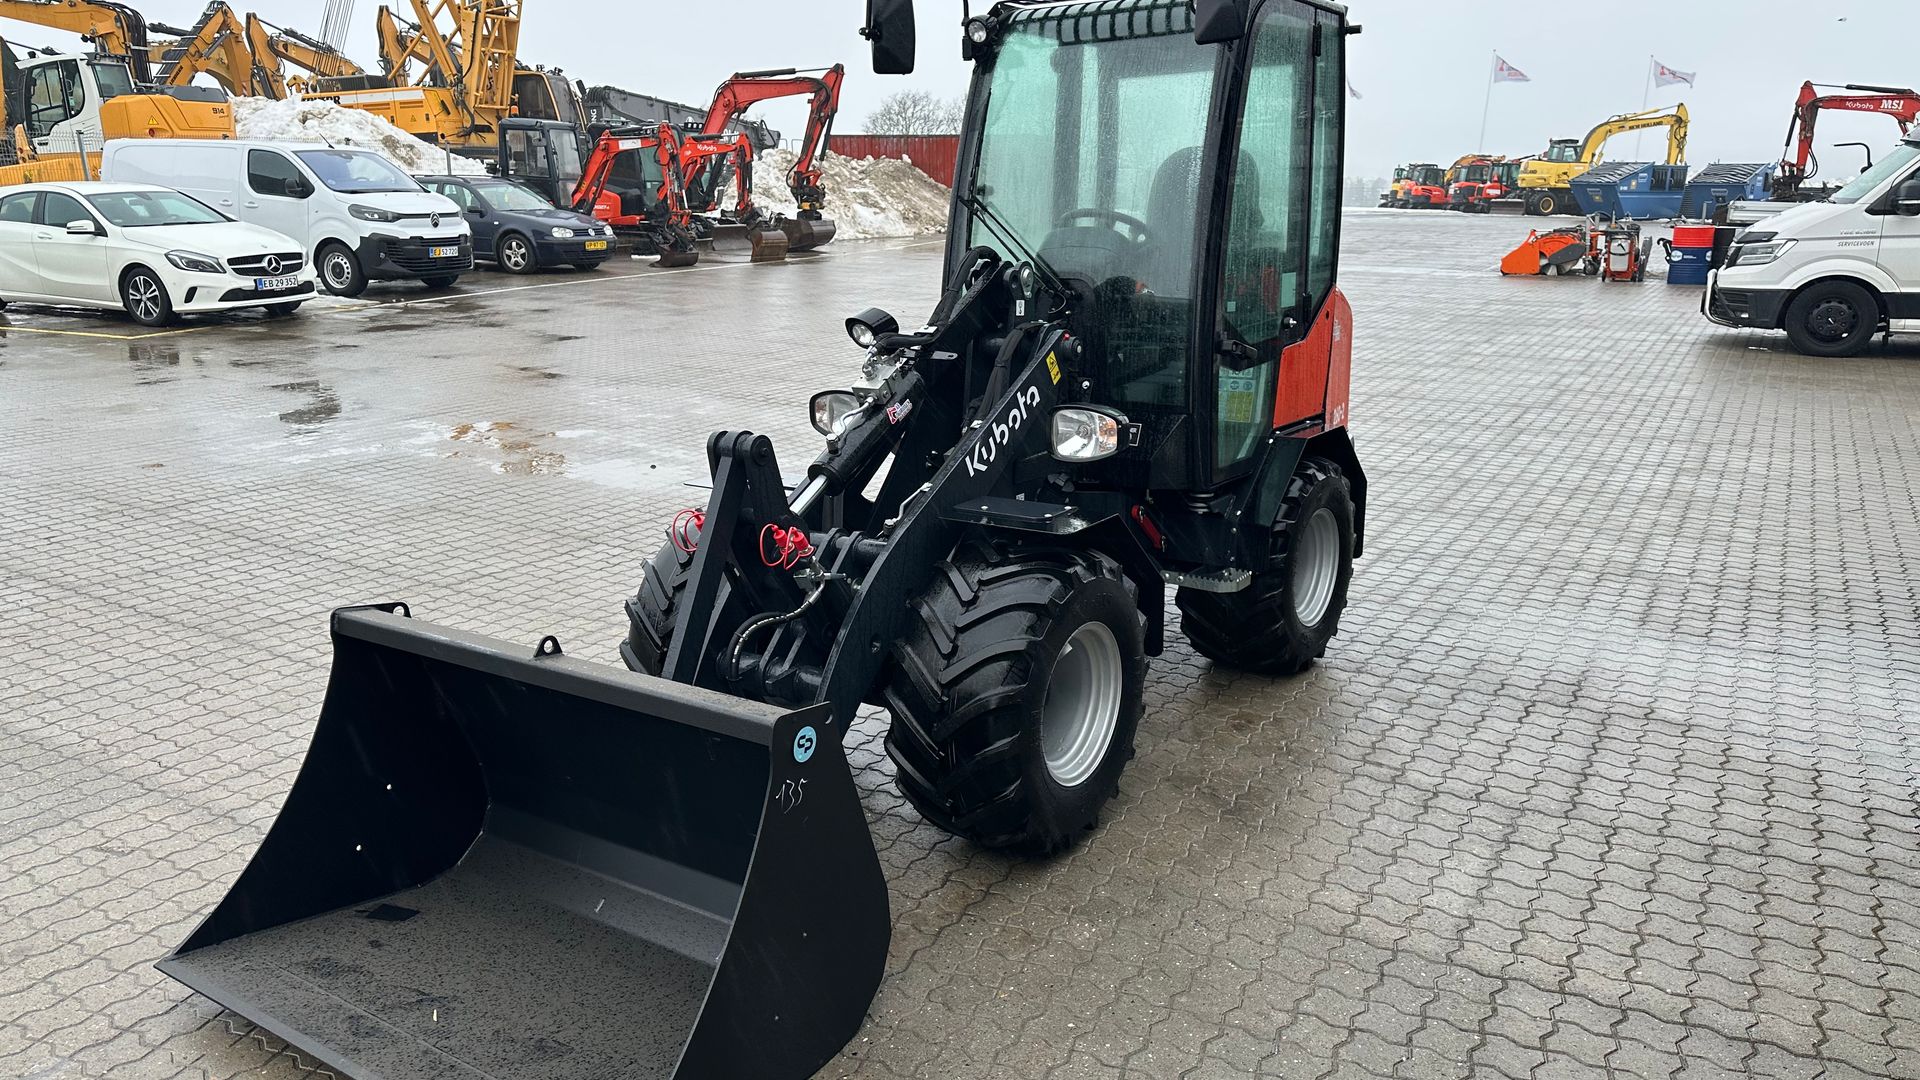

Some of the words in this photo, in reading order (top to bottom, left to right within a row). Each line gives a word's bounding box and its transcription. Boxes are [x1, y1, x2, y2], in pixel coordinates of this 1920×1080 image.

[1846, 101, 1874, 110] Kubota
[211, 107, 225, 115] 914
[263, 280, 273, 288] EB
[275, 278, 284, 286] 29
[285, 278, 296, 286] 352
[965, 385, 1041, 478] Kubota
[775, 778, 808, 814] 135
